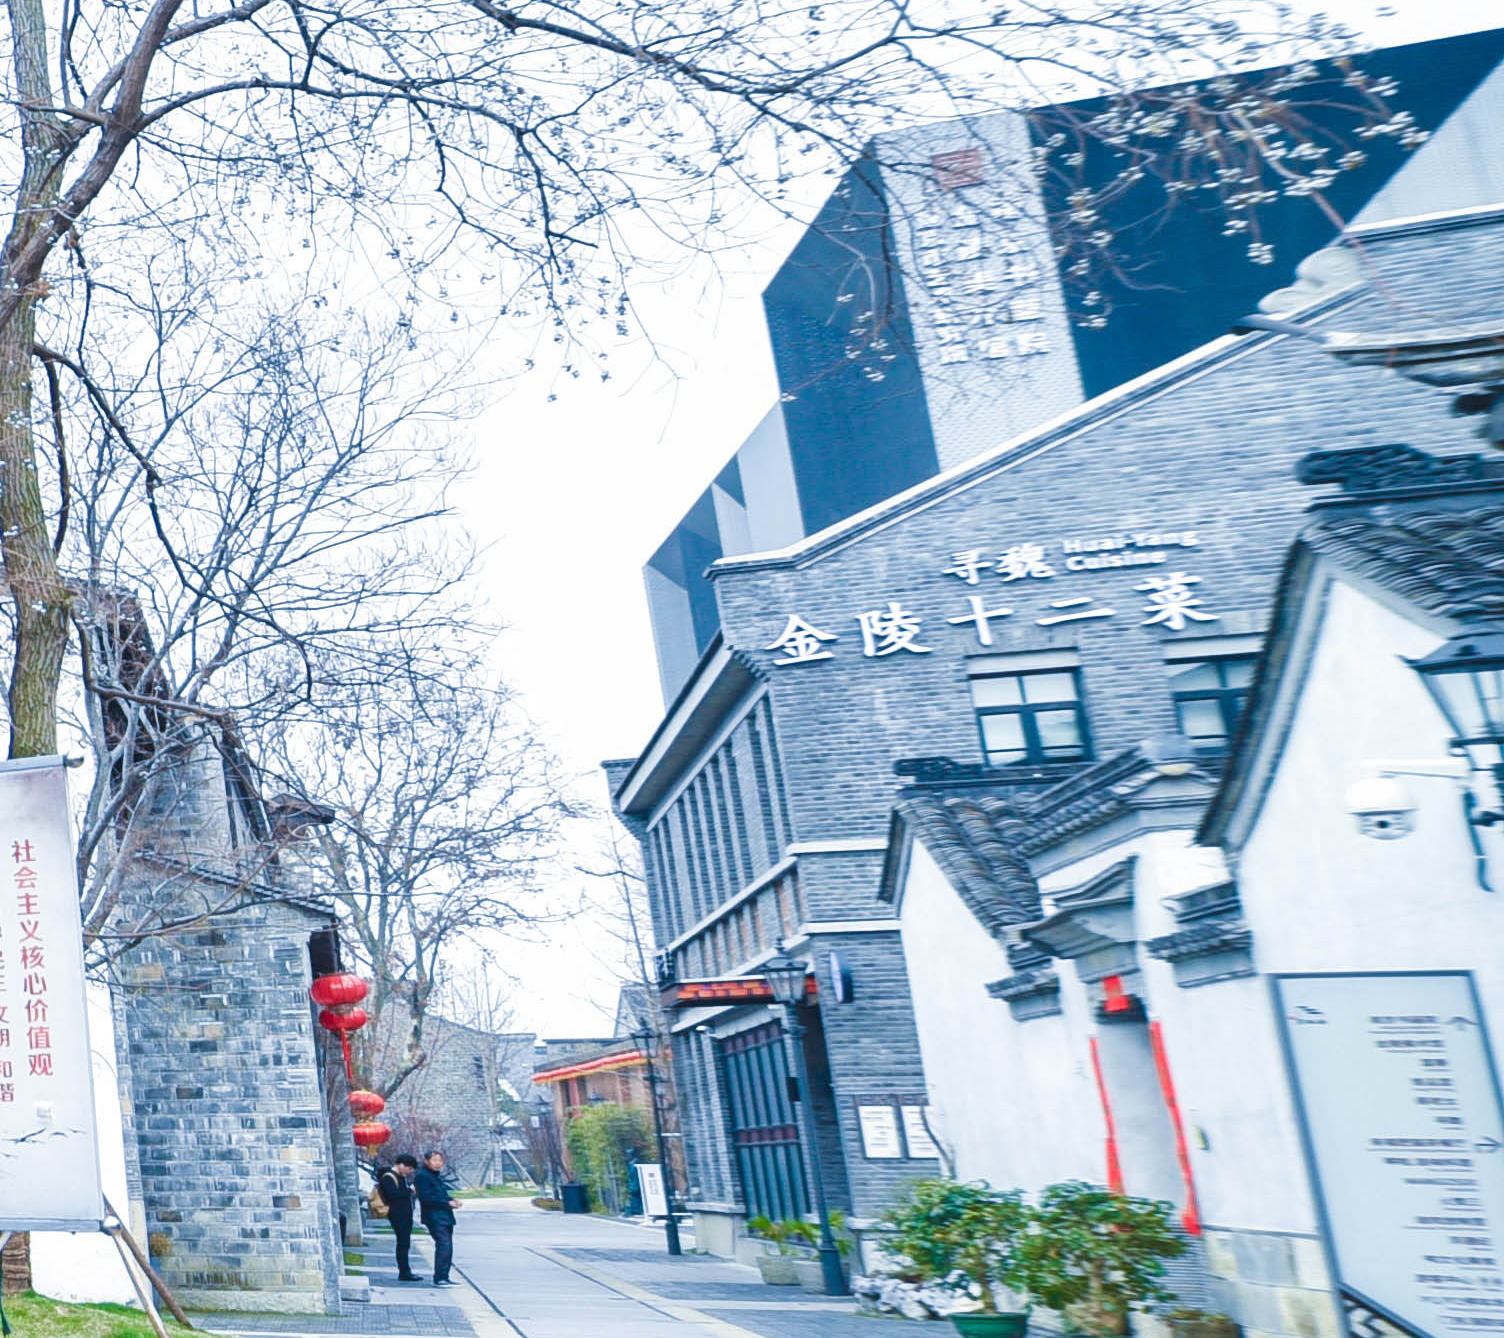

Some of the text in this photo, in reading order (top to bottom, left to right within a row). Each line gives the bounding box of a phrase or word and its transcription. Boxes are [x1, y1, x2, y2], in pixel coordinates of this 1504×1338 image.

[1066, 551, 1167, 571] Cuisine
[765, 571, 1219, 666] 金陵十二菜
[11, 839, 54, 1077] 社会主义核心价值观
